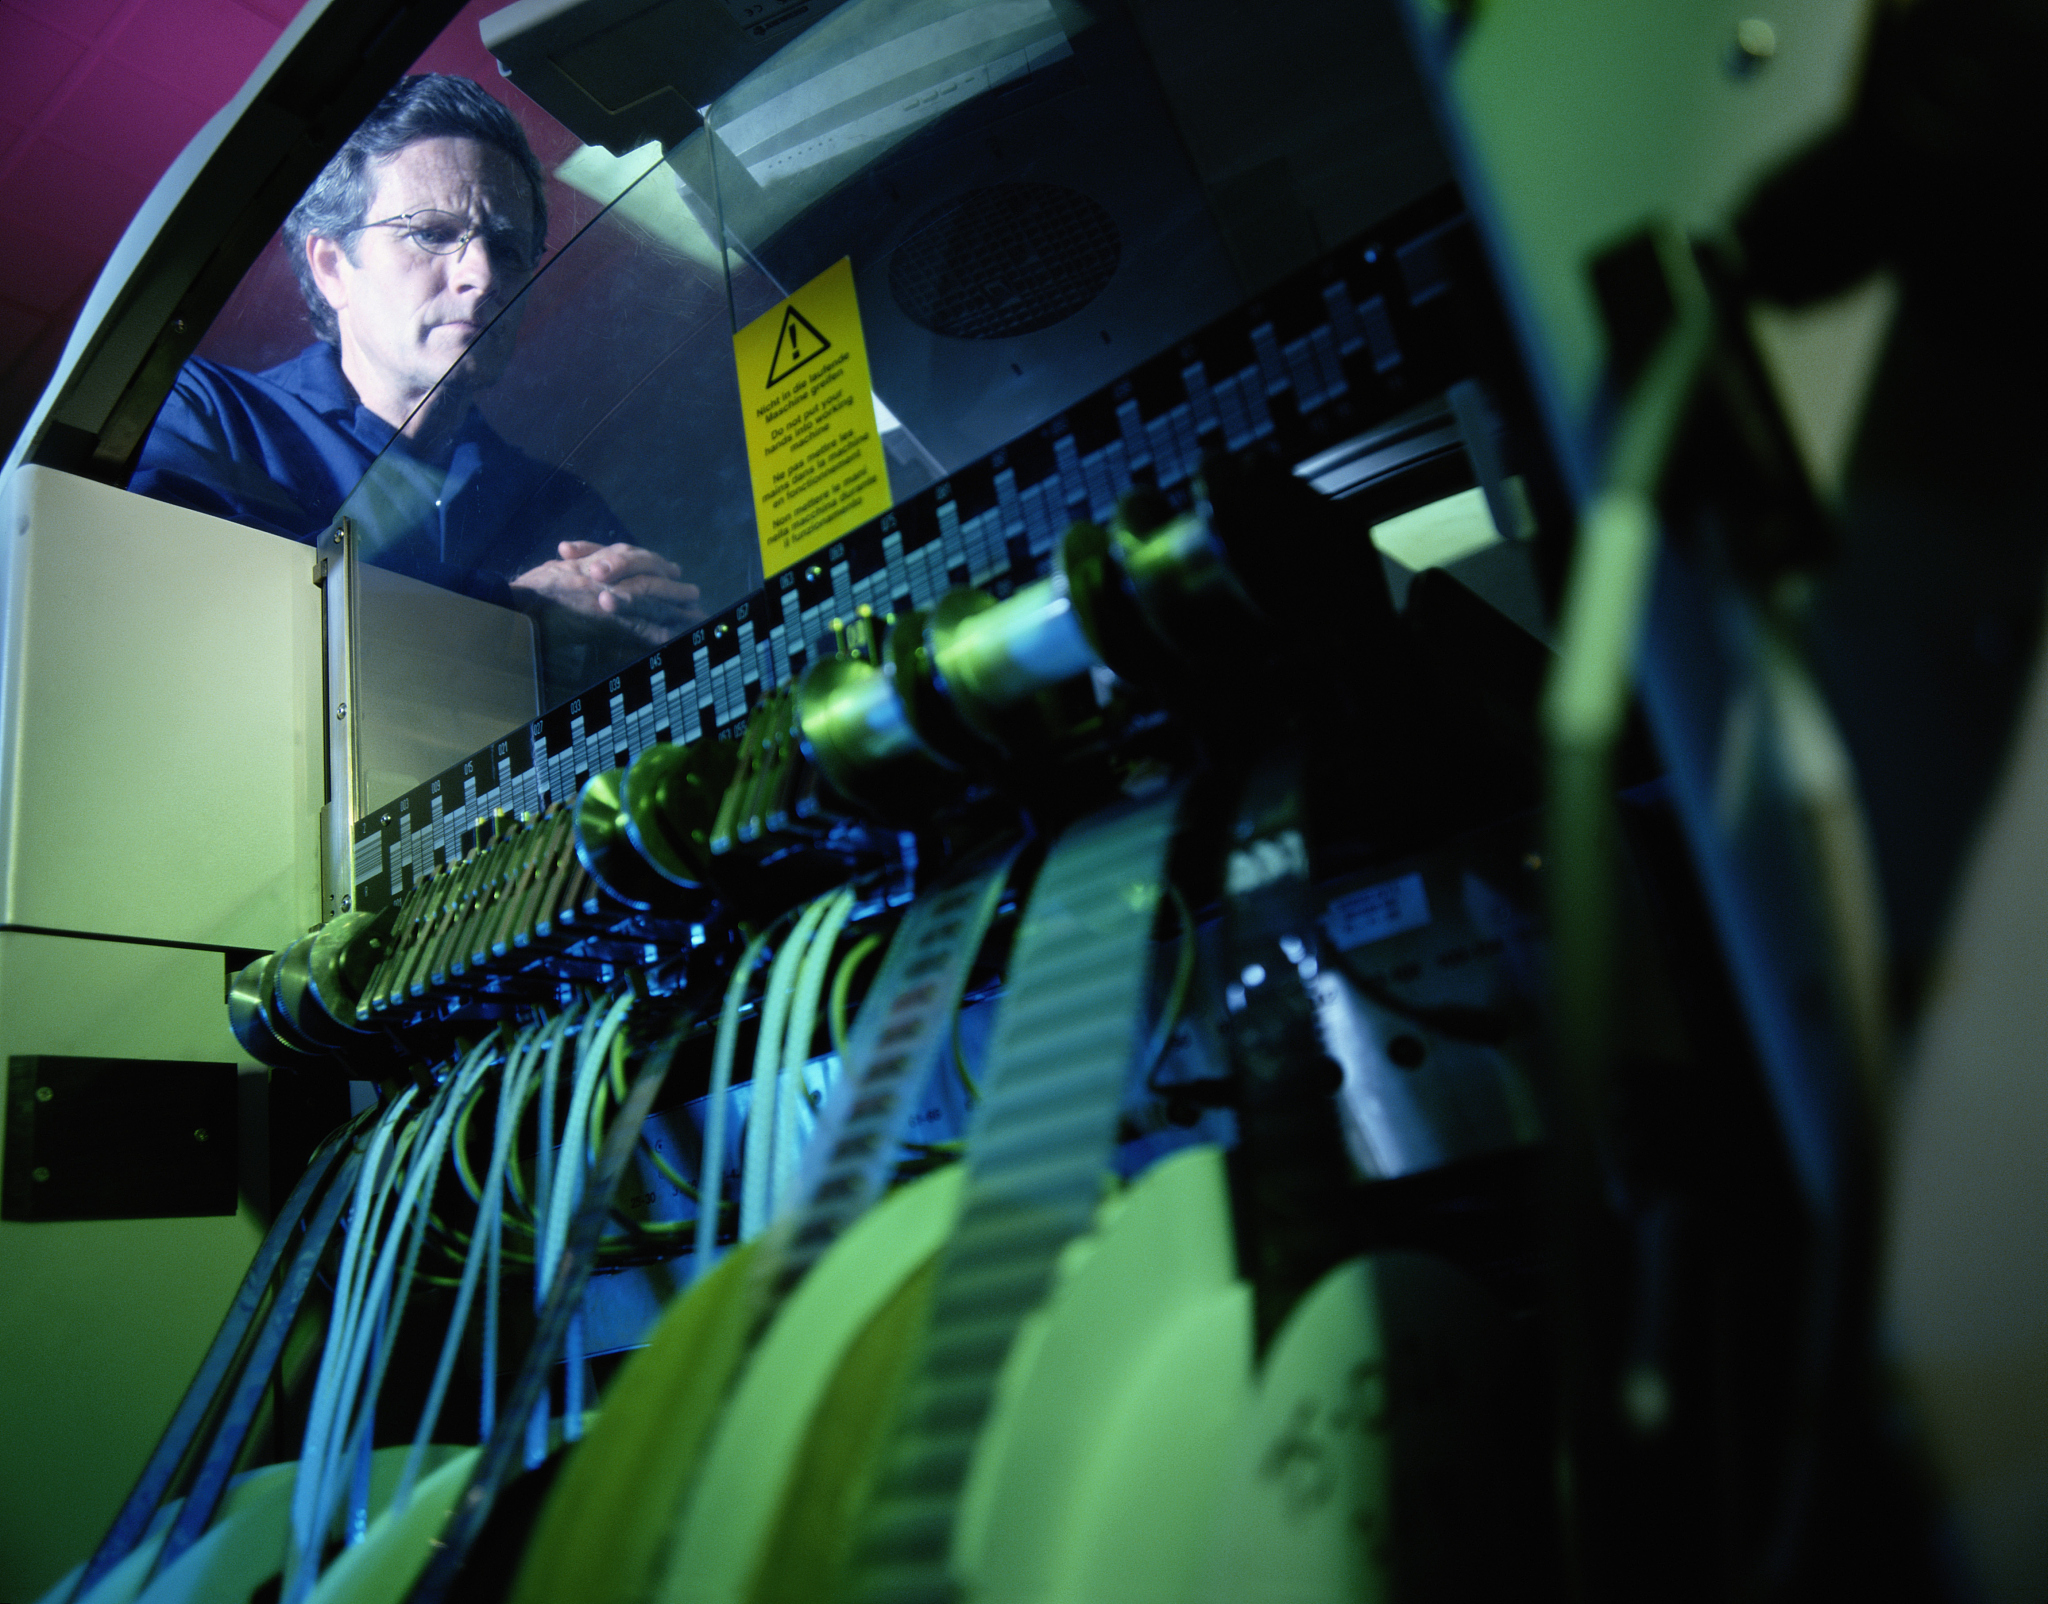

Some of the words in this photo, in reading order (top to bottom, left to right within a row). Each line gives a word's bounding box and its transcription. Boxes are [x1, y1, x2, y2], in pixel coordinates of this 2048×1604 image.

[757, 397, 780, 417] Nicht
[782, 390, 791, 401] in
[793, 380, 807, 393] die
[809, 352, 849, 382] laufende
[765, 391, 808, 423] Maschine
[811, 368, 843, 396] greifen
[765, 434, 792, 456] hands
[795, 421, 813, 437] into
[815, 395, 854, 423] working
[771, 427, 784, 440] Do
[786, 415, 801, 430] not
[803, 404, 819, 420] put
[822, 389, 842, 409] your
[790, 423, 829, 452] machine
[762, 481, 789, 503] mains
[792, 465, 815, 484] dans
[817, 459, 826, 469] la
[828, 432, 869, 461] machine
[773, 471, 785, 484] Ne
[787, 460, 804, 476] pas
[807, 439, 837, 462] mettre
[839, 429, 854, 442] les
[773, 497, 784, 508] en
[786, 449, 862, 500] fonctionnement
[767, 527, 789, 546] nella
[791, 500, 837, 531] macchina
[840, 475, 877, 502] durante
[773, 513, 792, 529] Non
[794, 490, 830, 516] mettere
[831, 483, 841, 493] le
[843, 466, 868, 486] mani
[792, 497, 863, 543] funzionamento
[609, 676, 621, 693] 039
[649, 653, 662, 670] 045
[533, 720, 543, 736] 027
[570, 699, 582, 715] 033
[464, 760, 474, 776] 015
[498, 741, 508, 756] 021
